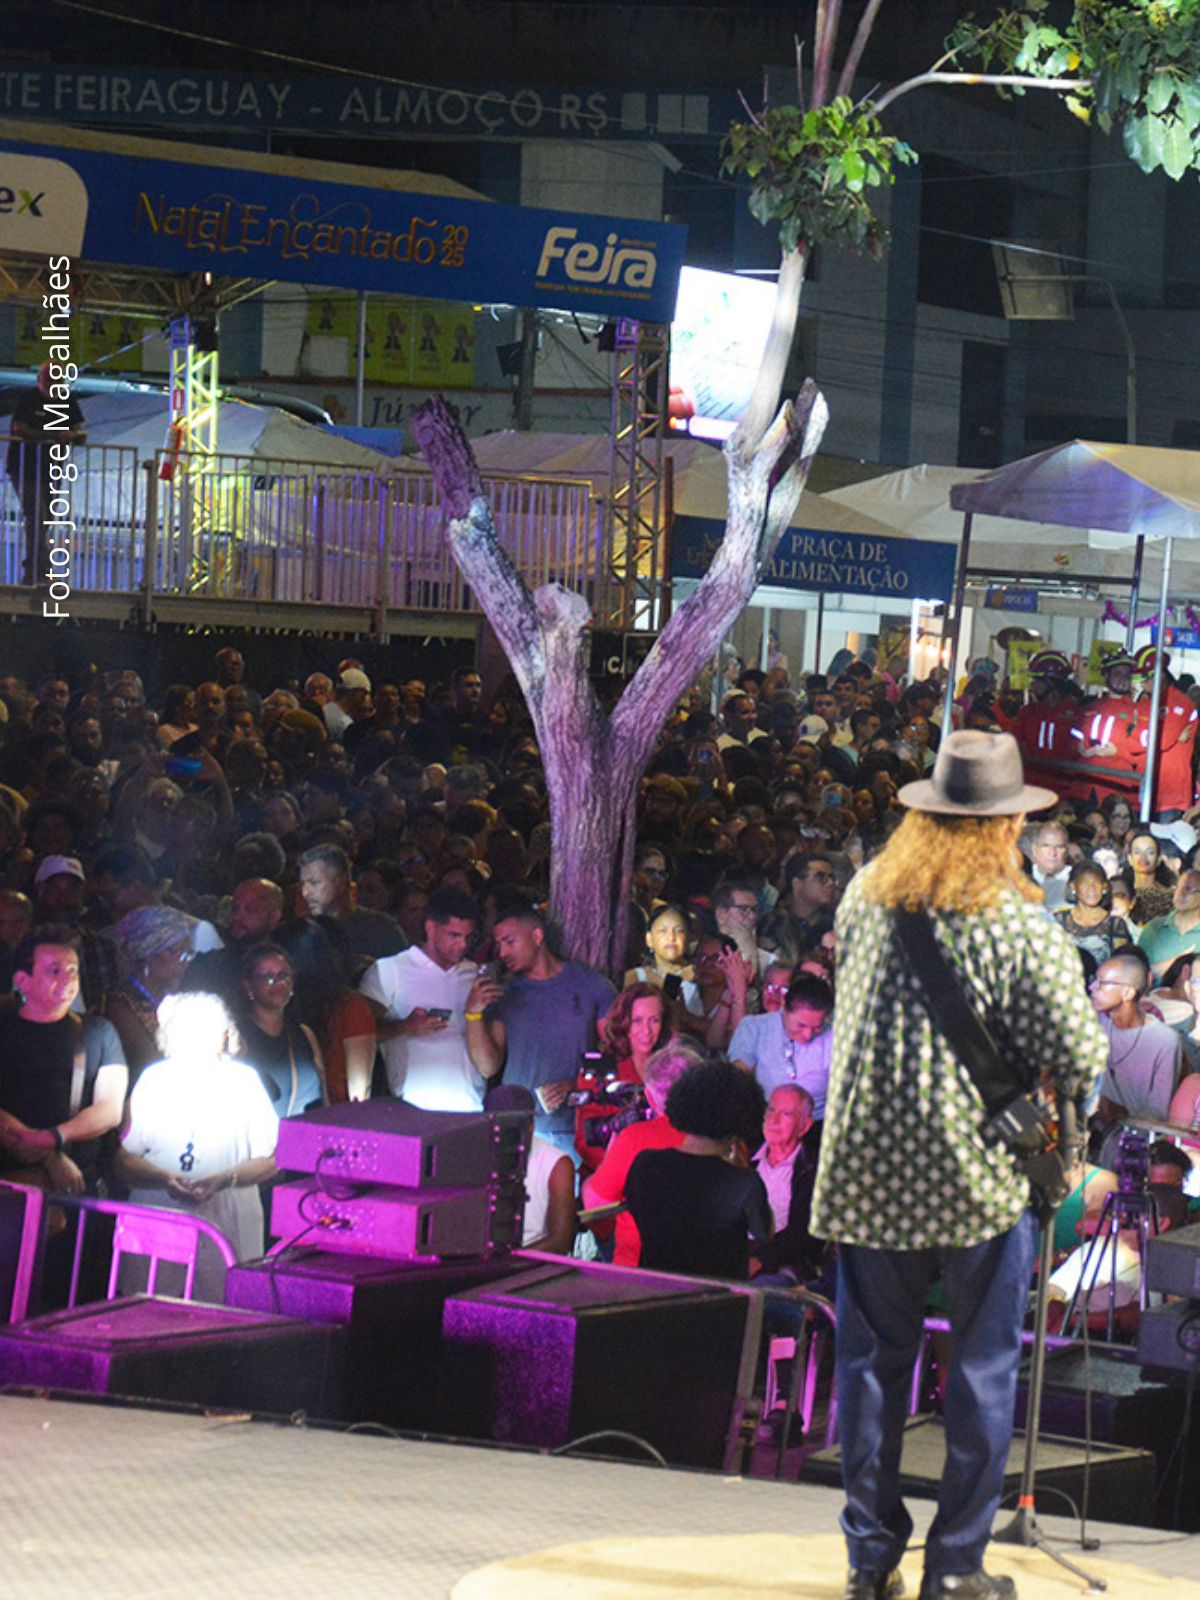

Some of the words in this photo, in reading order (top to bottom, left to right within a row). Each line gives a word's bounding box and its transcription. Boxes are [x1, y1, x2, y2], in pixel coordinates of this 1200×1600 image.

[55, 75, 291, 119] FEIRAGUAY
[339, 86, 543, 133] ALMOÇO
[559, 92, 609, 136] R$
[134, 190, 248, 252] Natal
[239, 194, 438, 266] Encantado
[536, 226, 657, 288] Feira
[765, 557, 909, 591] ALIMENTAÇÃO
[791, 534, 855, 567] PRAÇA
[859, 542, 888, 563] DE
